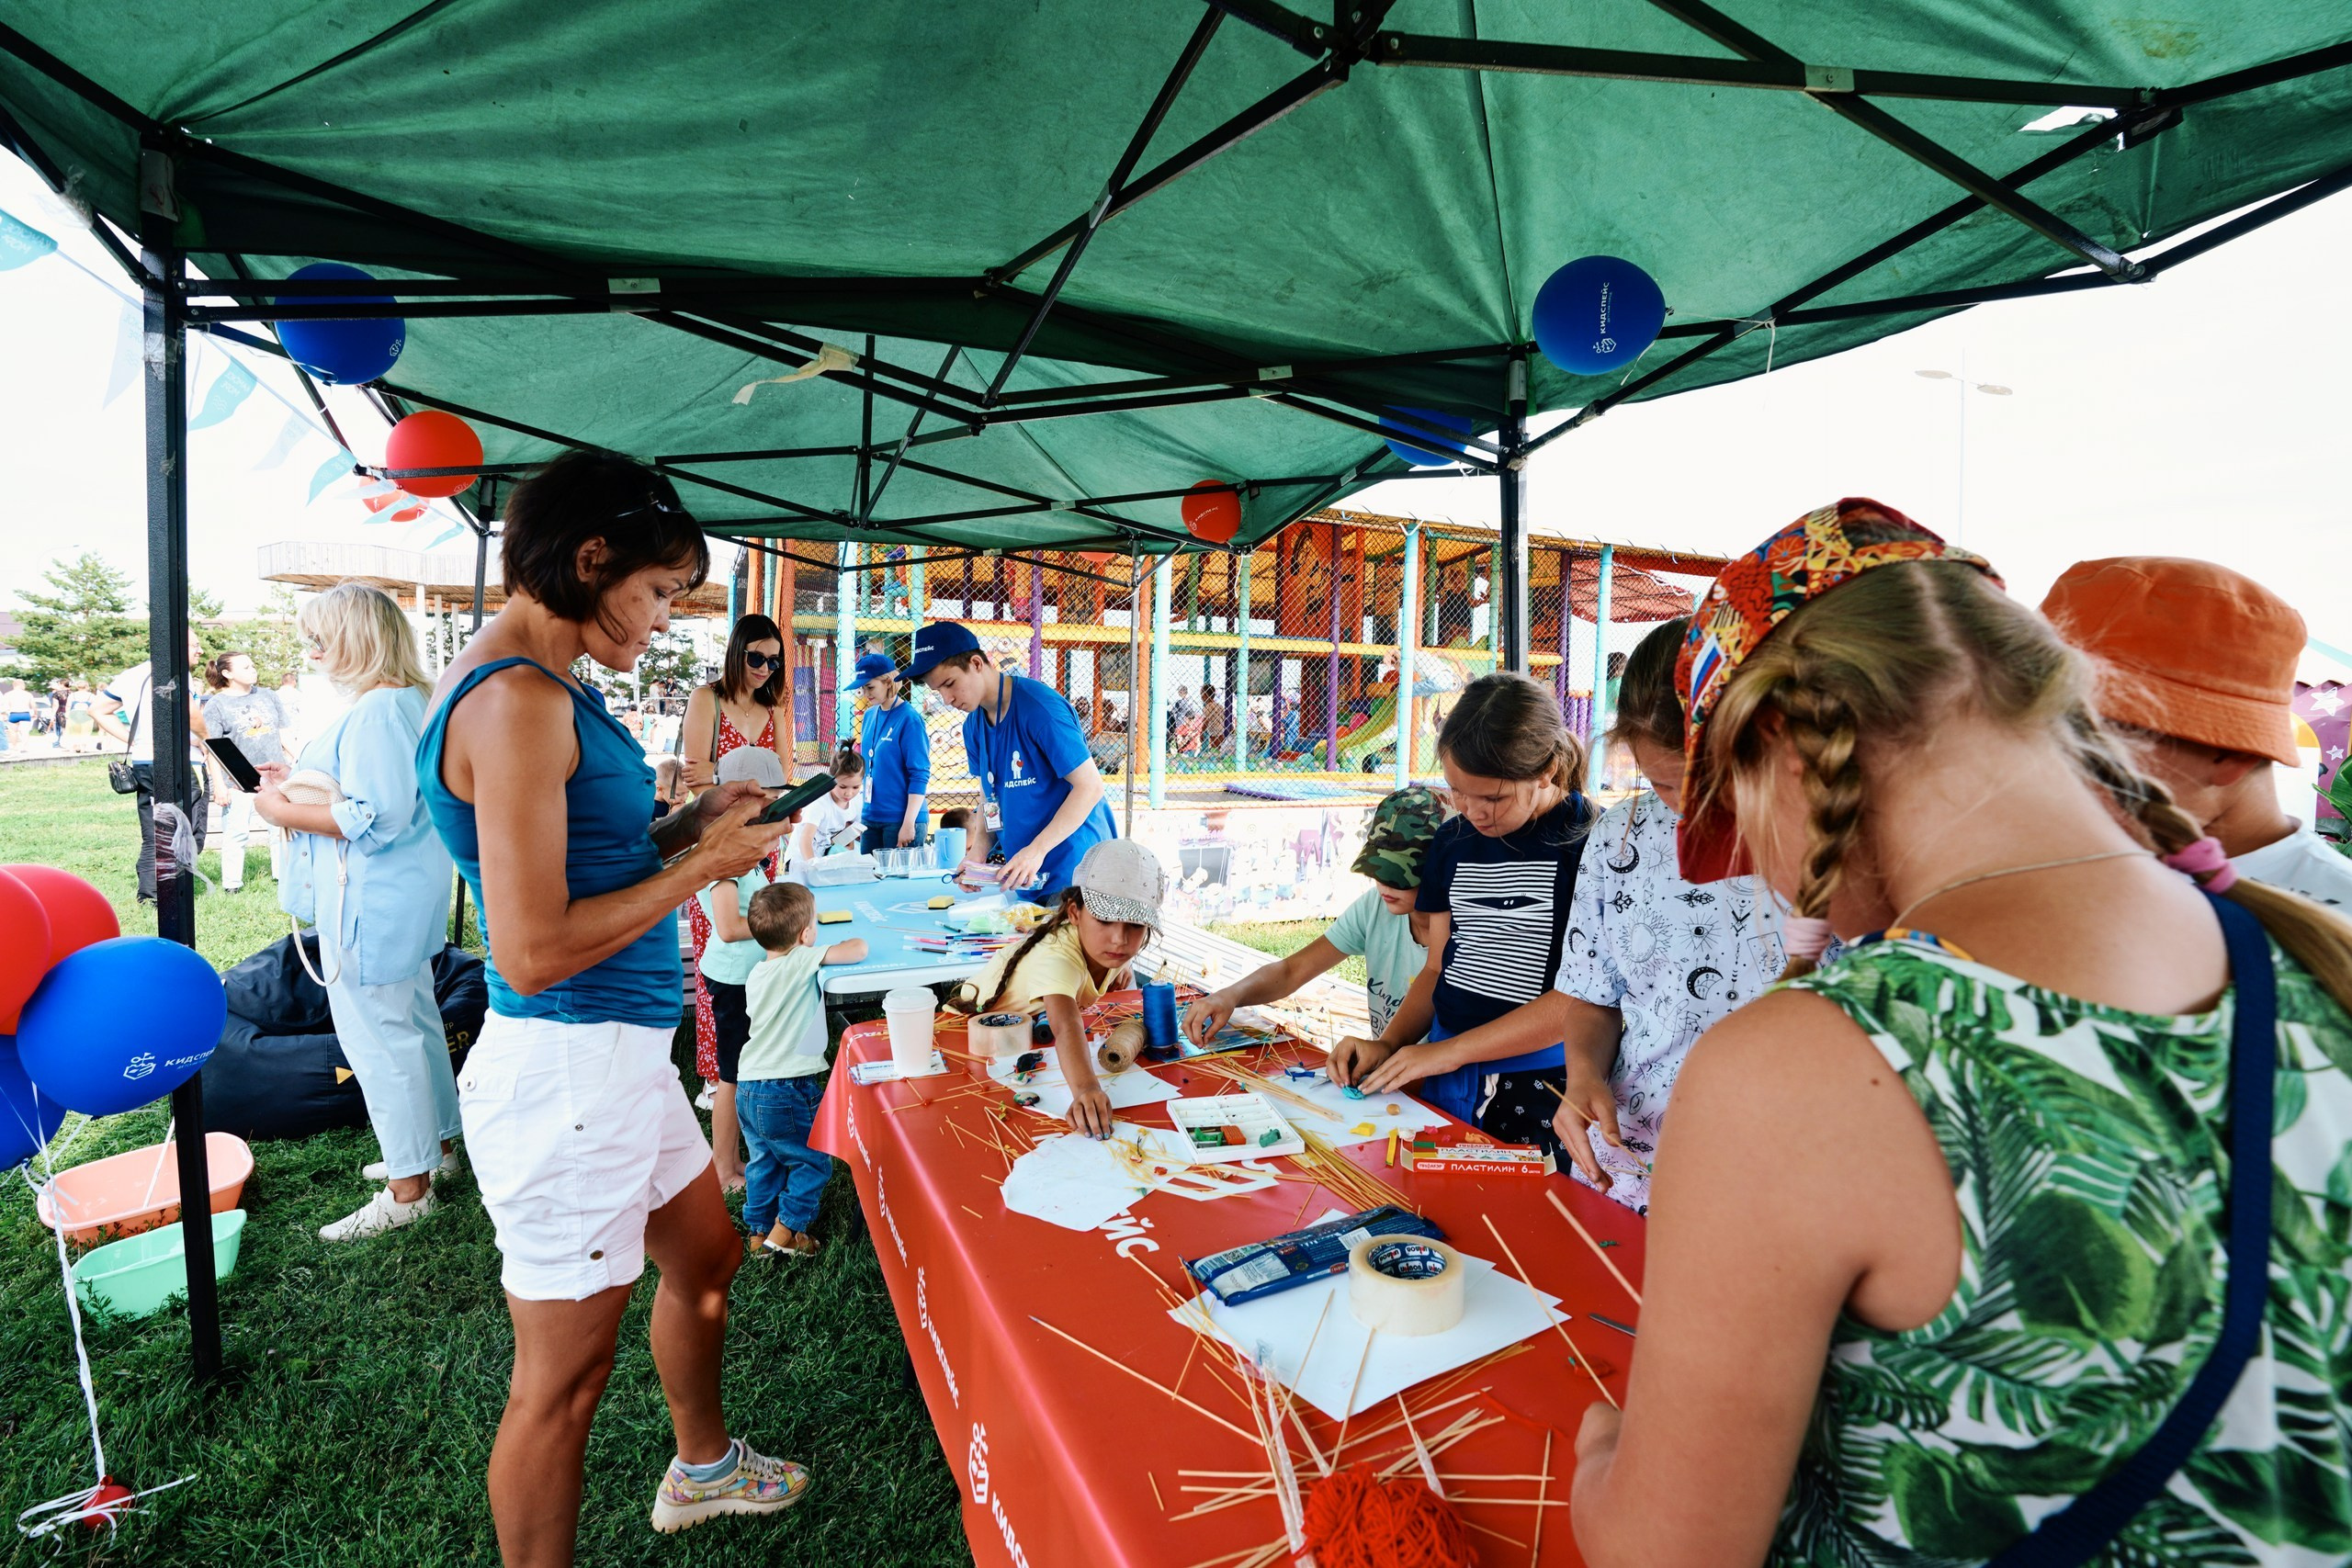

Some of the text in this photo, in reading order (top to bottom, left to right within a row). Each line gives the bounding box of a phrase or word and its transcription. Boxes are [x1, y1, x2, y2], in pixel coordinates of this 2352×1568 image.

[1600, 281, 1610, 334] КИДСПЕЙС
[1451, 1163, 1516, 1173] ПЛАСТИЛИН
[1521, 1164, 1528, 1174] 6
